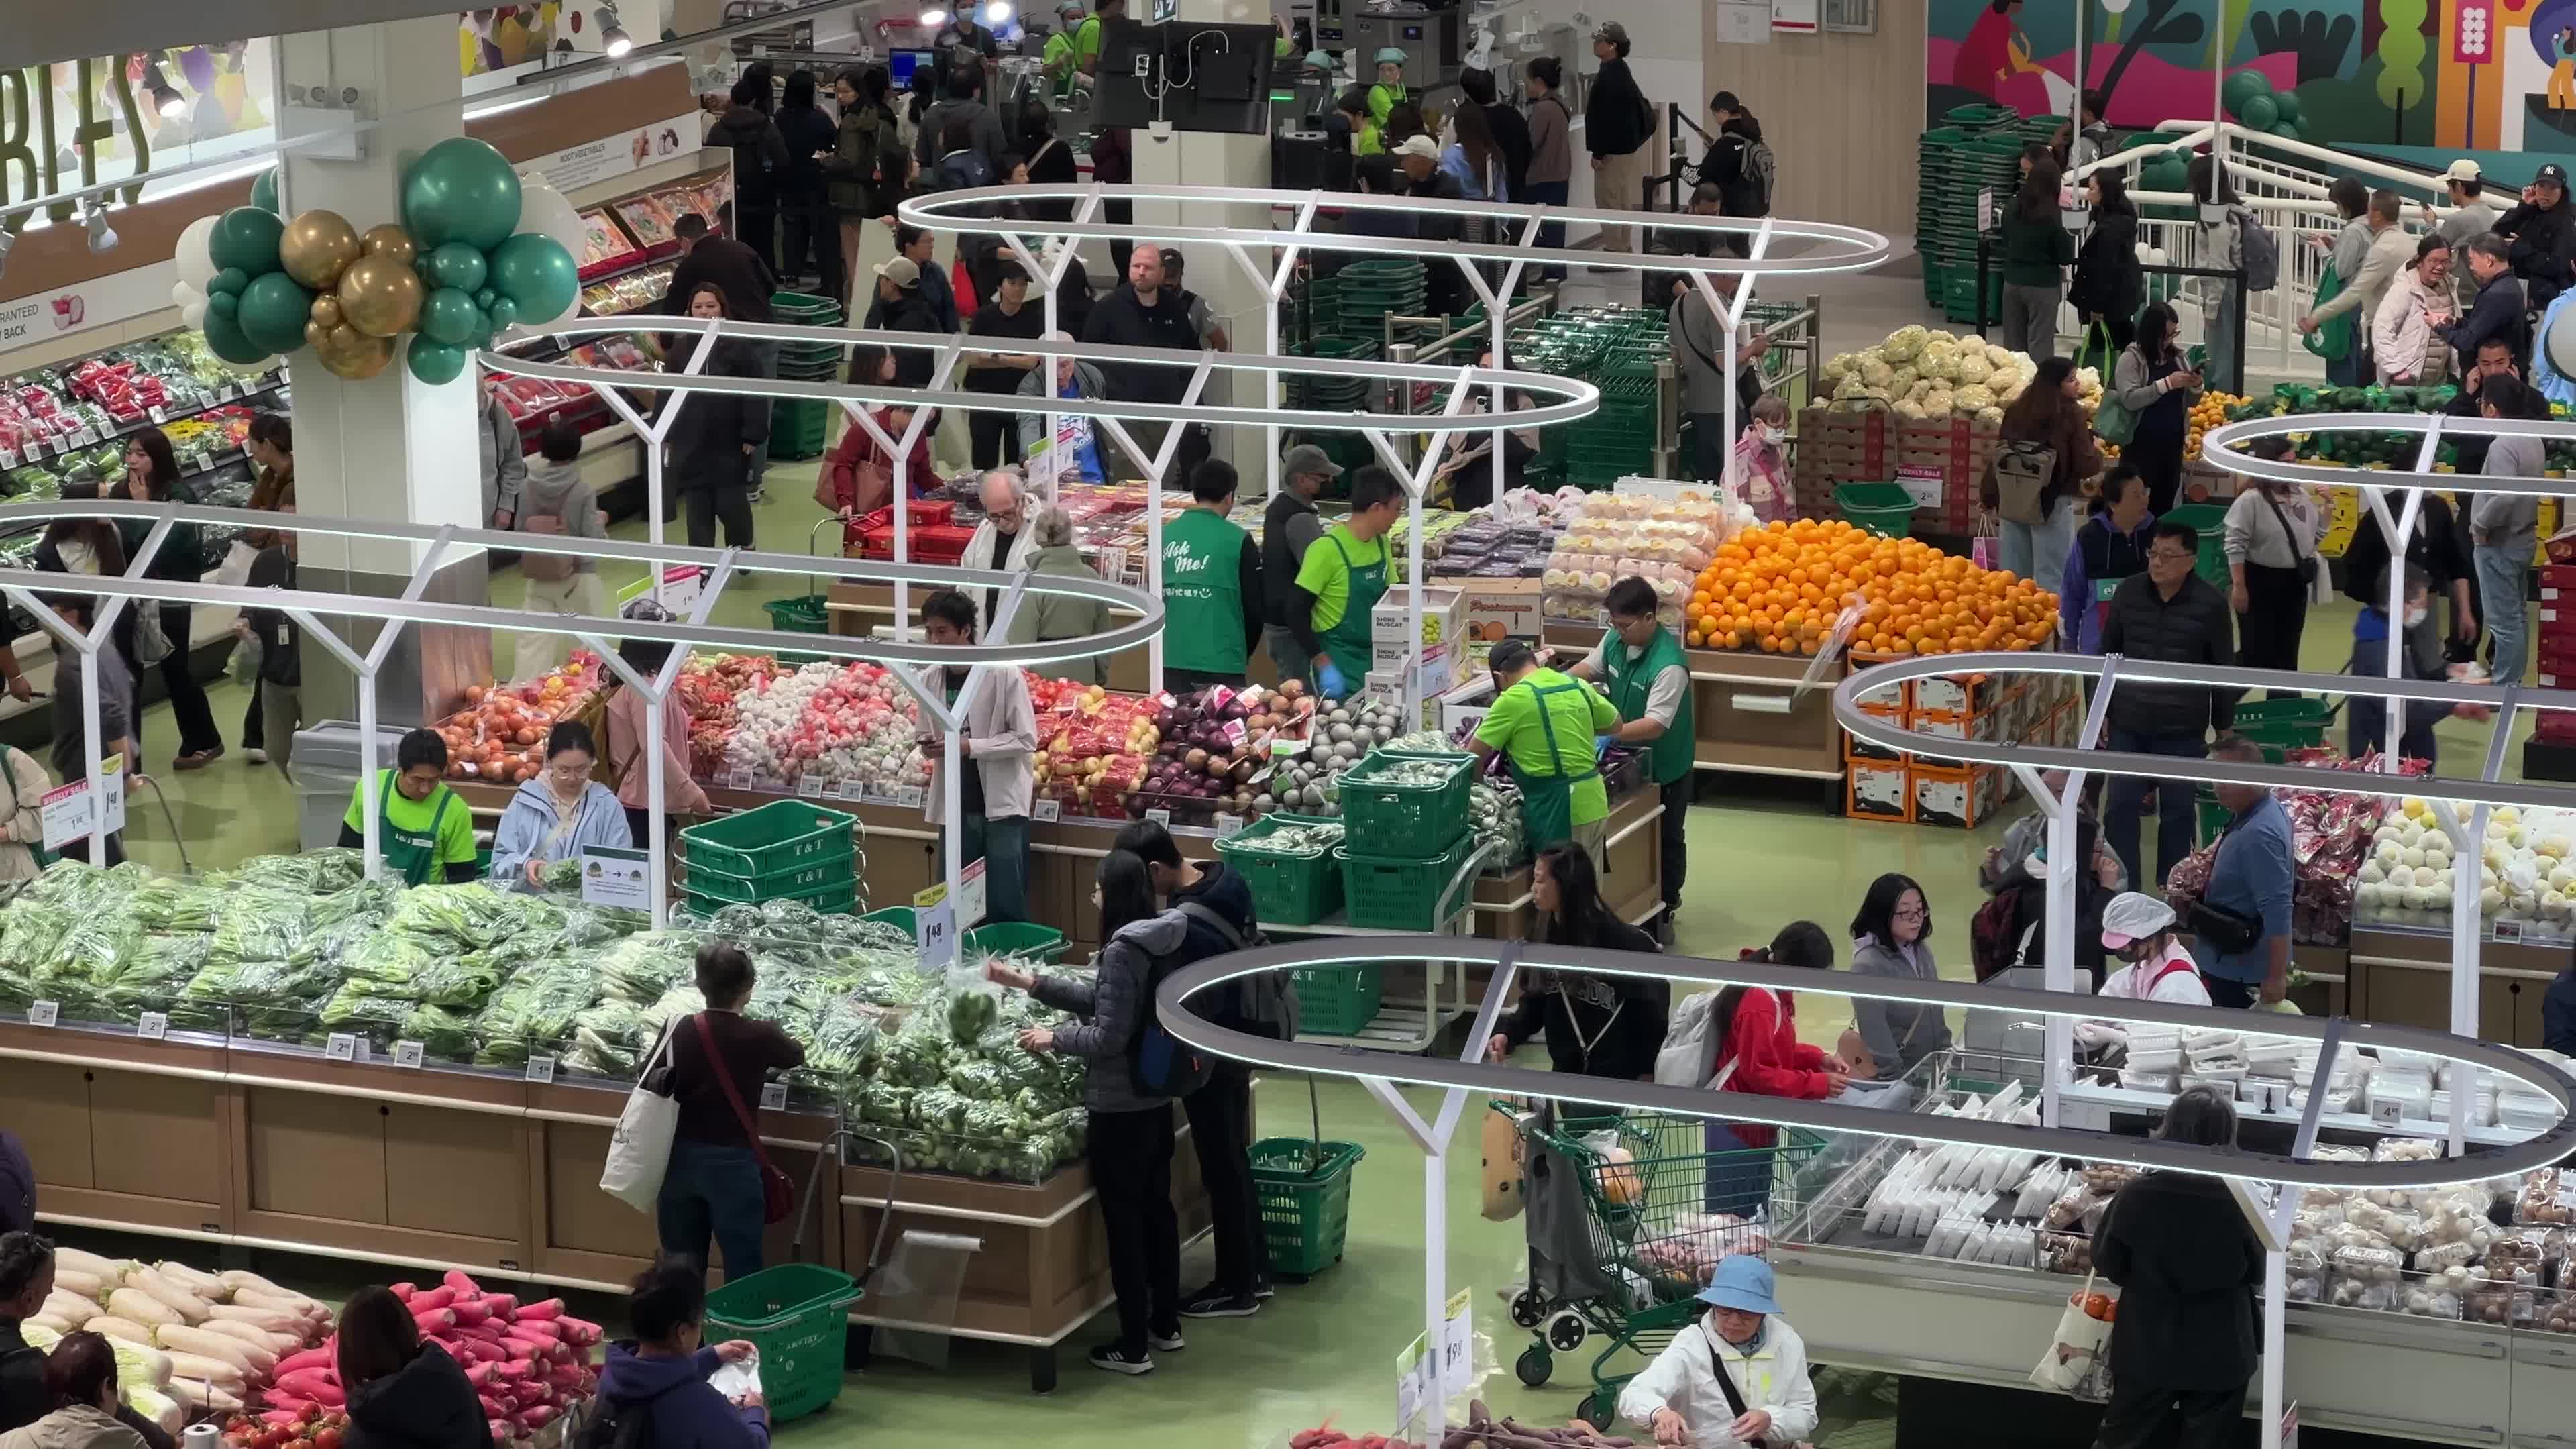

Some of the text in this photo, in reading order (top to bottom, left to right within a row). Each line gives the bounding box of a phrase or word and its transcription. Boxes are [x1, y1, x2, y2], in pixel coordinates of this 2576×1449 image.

[0, 304, 38, 323] RANTEED
[4, 324, 27, 339] BACK
[1163, 541, 1191, 561] Ask
[1175, 554, 1210, 574] Me!
[43, 782, 87, 805] WEEKLY SALE
